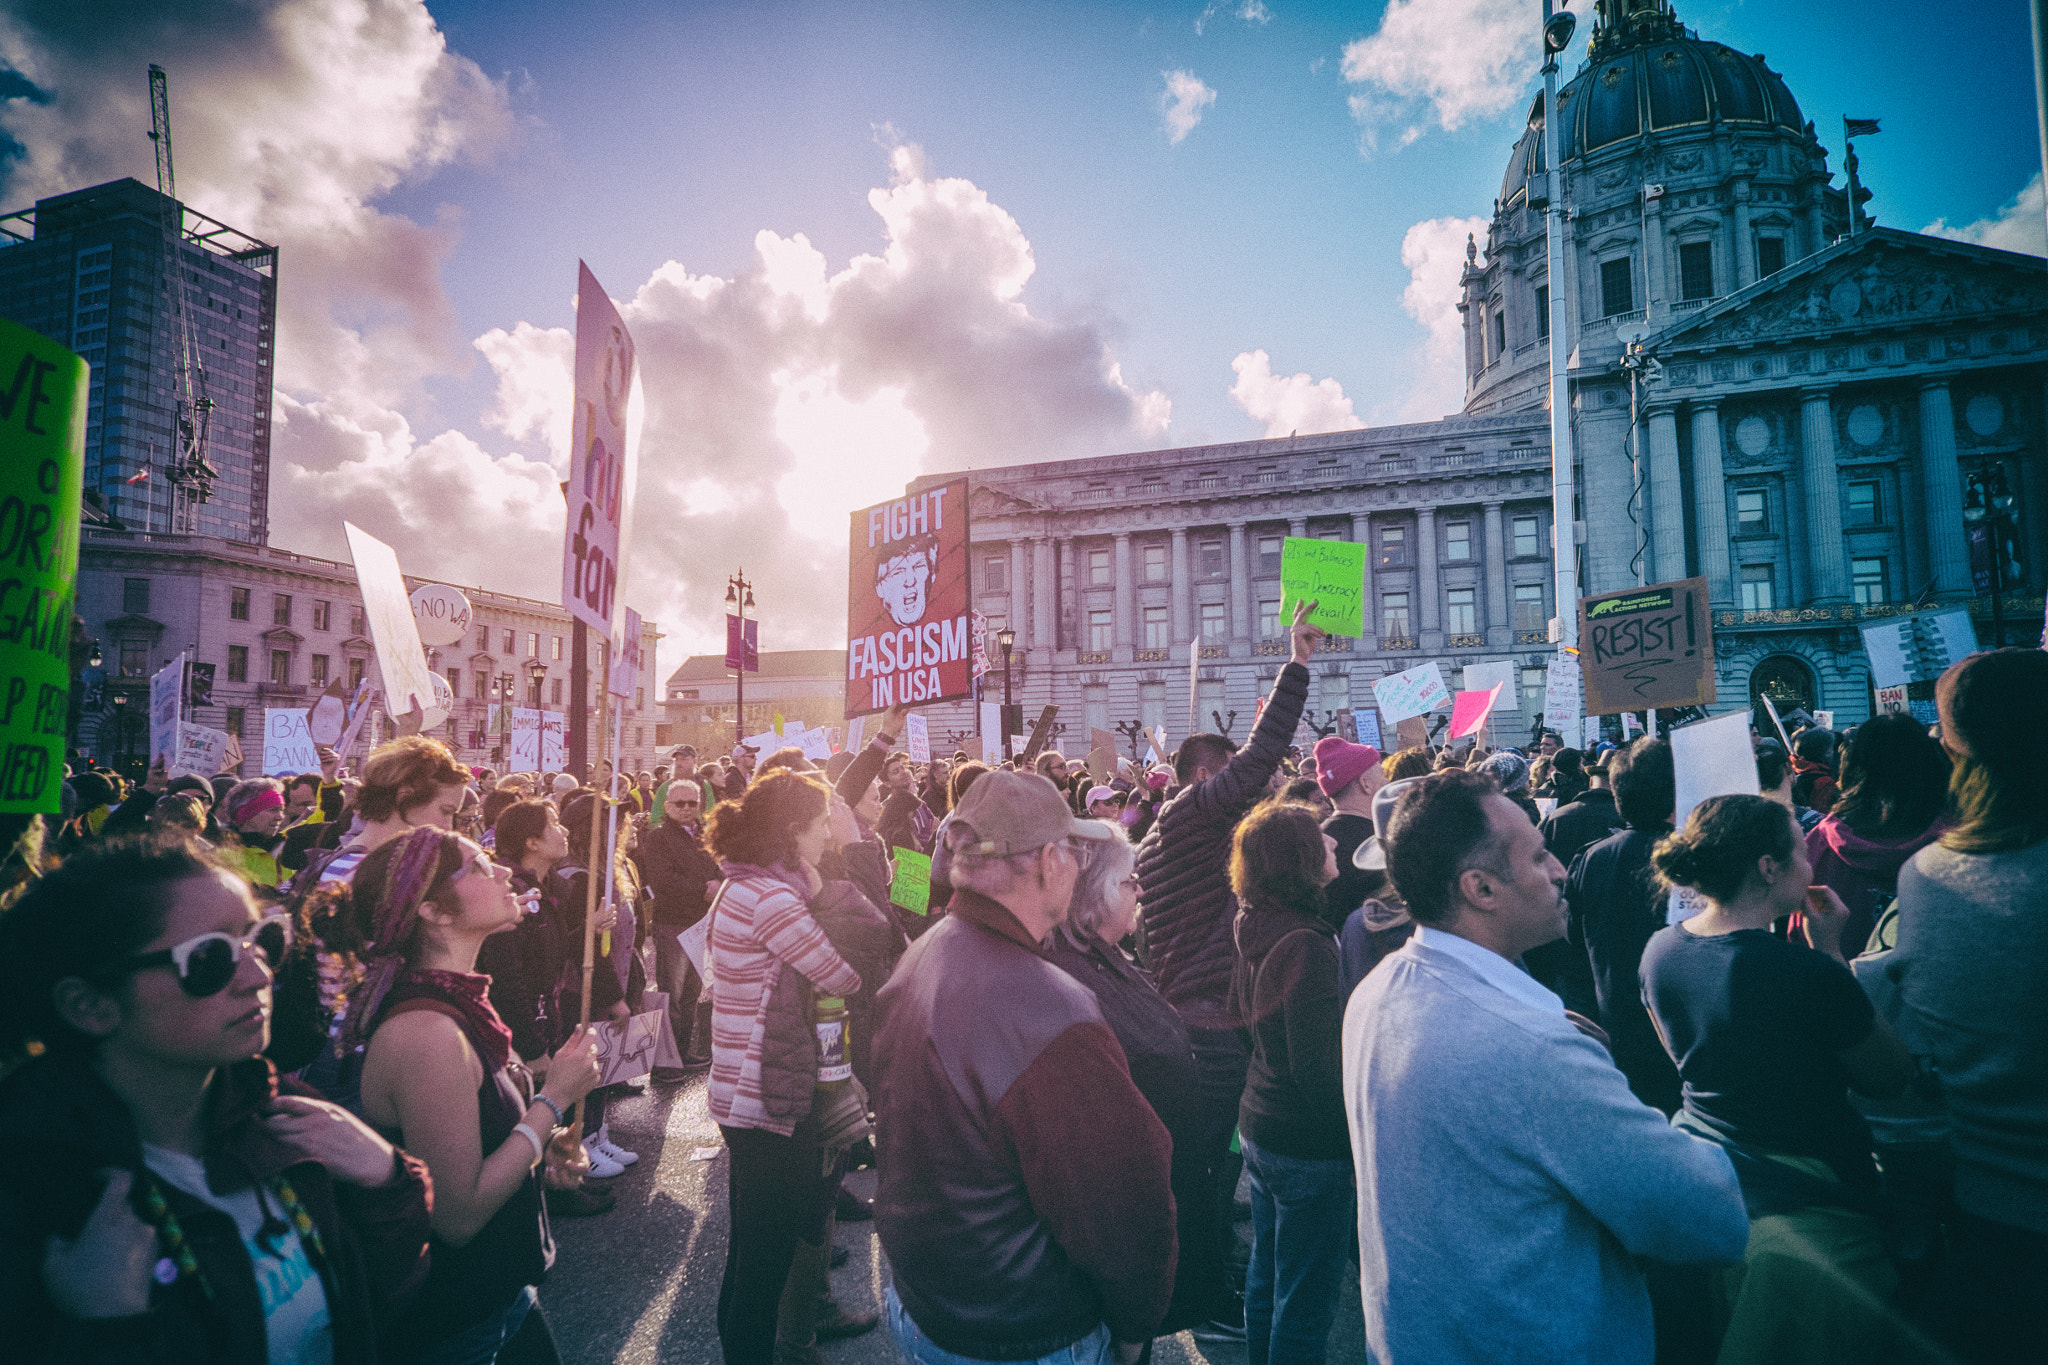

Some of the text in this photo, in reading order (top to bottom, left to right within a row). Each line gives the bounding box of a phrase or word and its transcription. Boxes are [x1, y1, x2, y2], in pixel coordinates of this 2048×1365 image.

[868, 488, 947, 548] FIGHT
[1312, 571, 1359, 602] Democracy
[421, 598, 446, 619] NO
[1614, 599, 1671, 613] ACTION NETWORK
[1622, 595, 1661, 606] RAINFOREST
[1313, 604, 1355, 620] revail!
[849, 616, 967, 680] FASCISM
[872, 666, 943, 709] IN USA
[1880, 689, 1904, 703] BAN
[1883, 701, 1901, 713] NO
[272, 714, 311, 739] BA
[512, 717, 563, 735] IMMIGANTS
[264, 745, 321, 768] BANN
